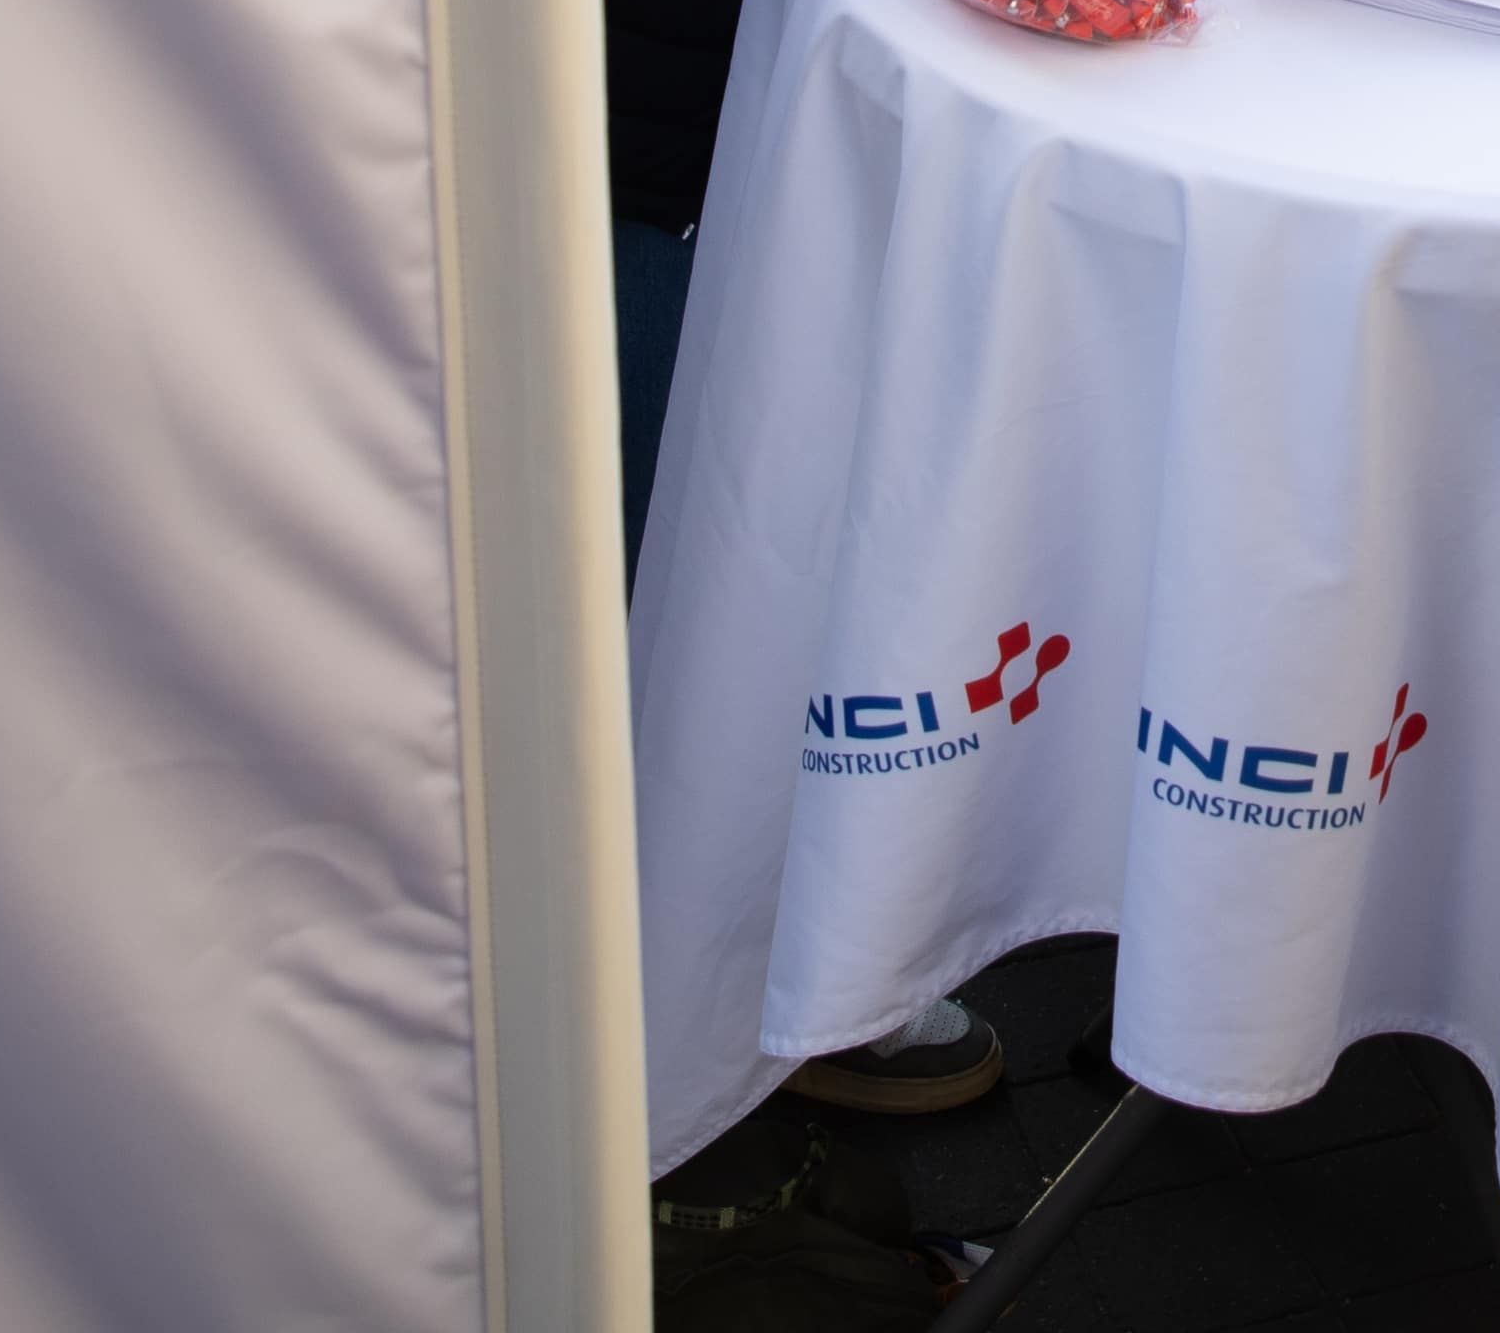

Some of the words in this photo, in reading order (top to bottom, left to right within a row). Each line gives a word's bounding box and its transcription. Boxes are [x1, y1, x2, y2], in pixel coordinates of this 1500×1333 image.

[804, 691, 941, 740] NCI
[801, 733, 980, 775] CONSTRUCTION
[1137, 706, 1350, 795] INCI
[1152, 778, 1366, 831] CONSTRUCTION
